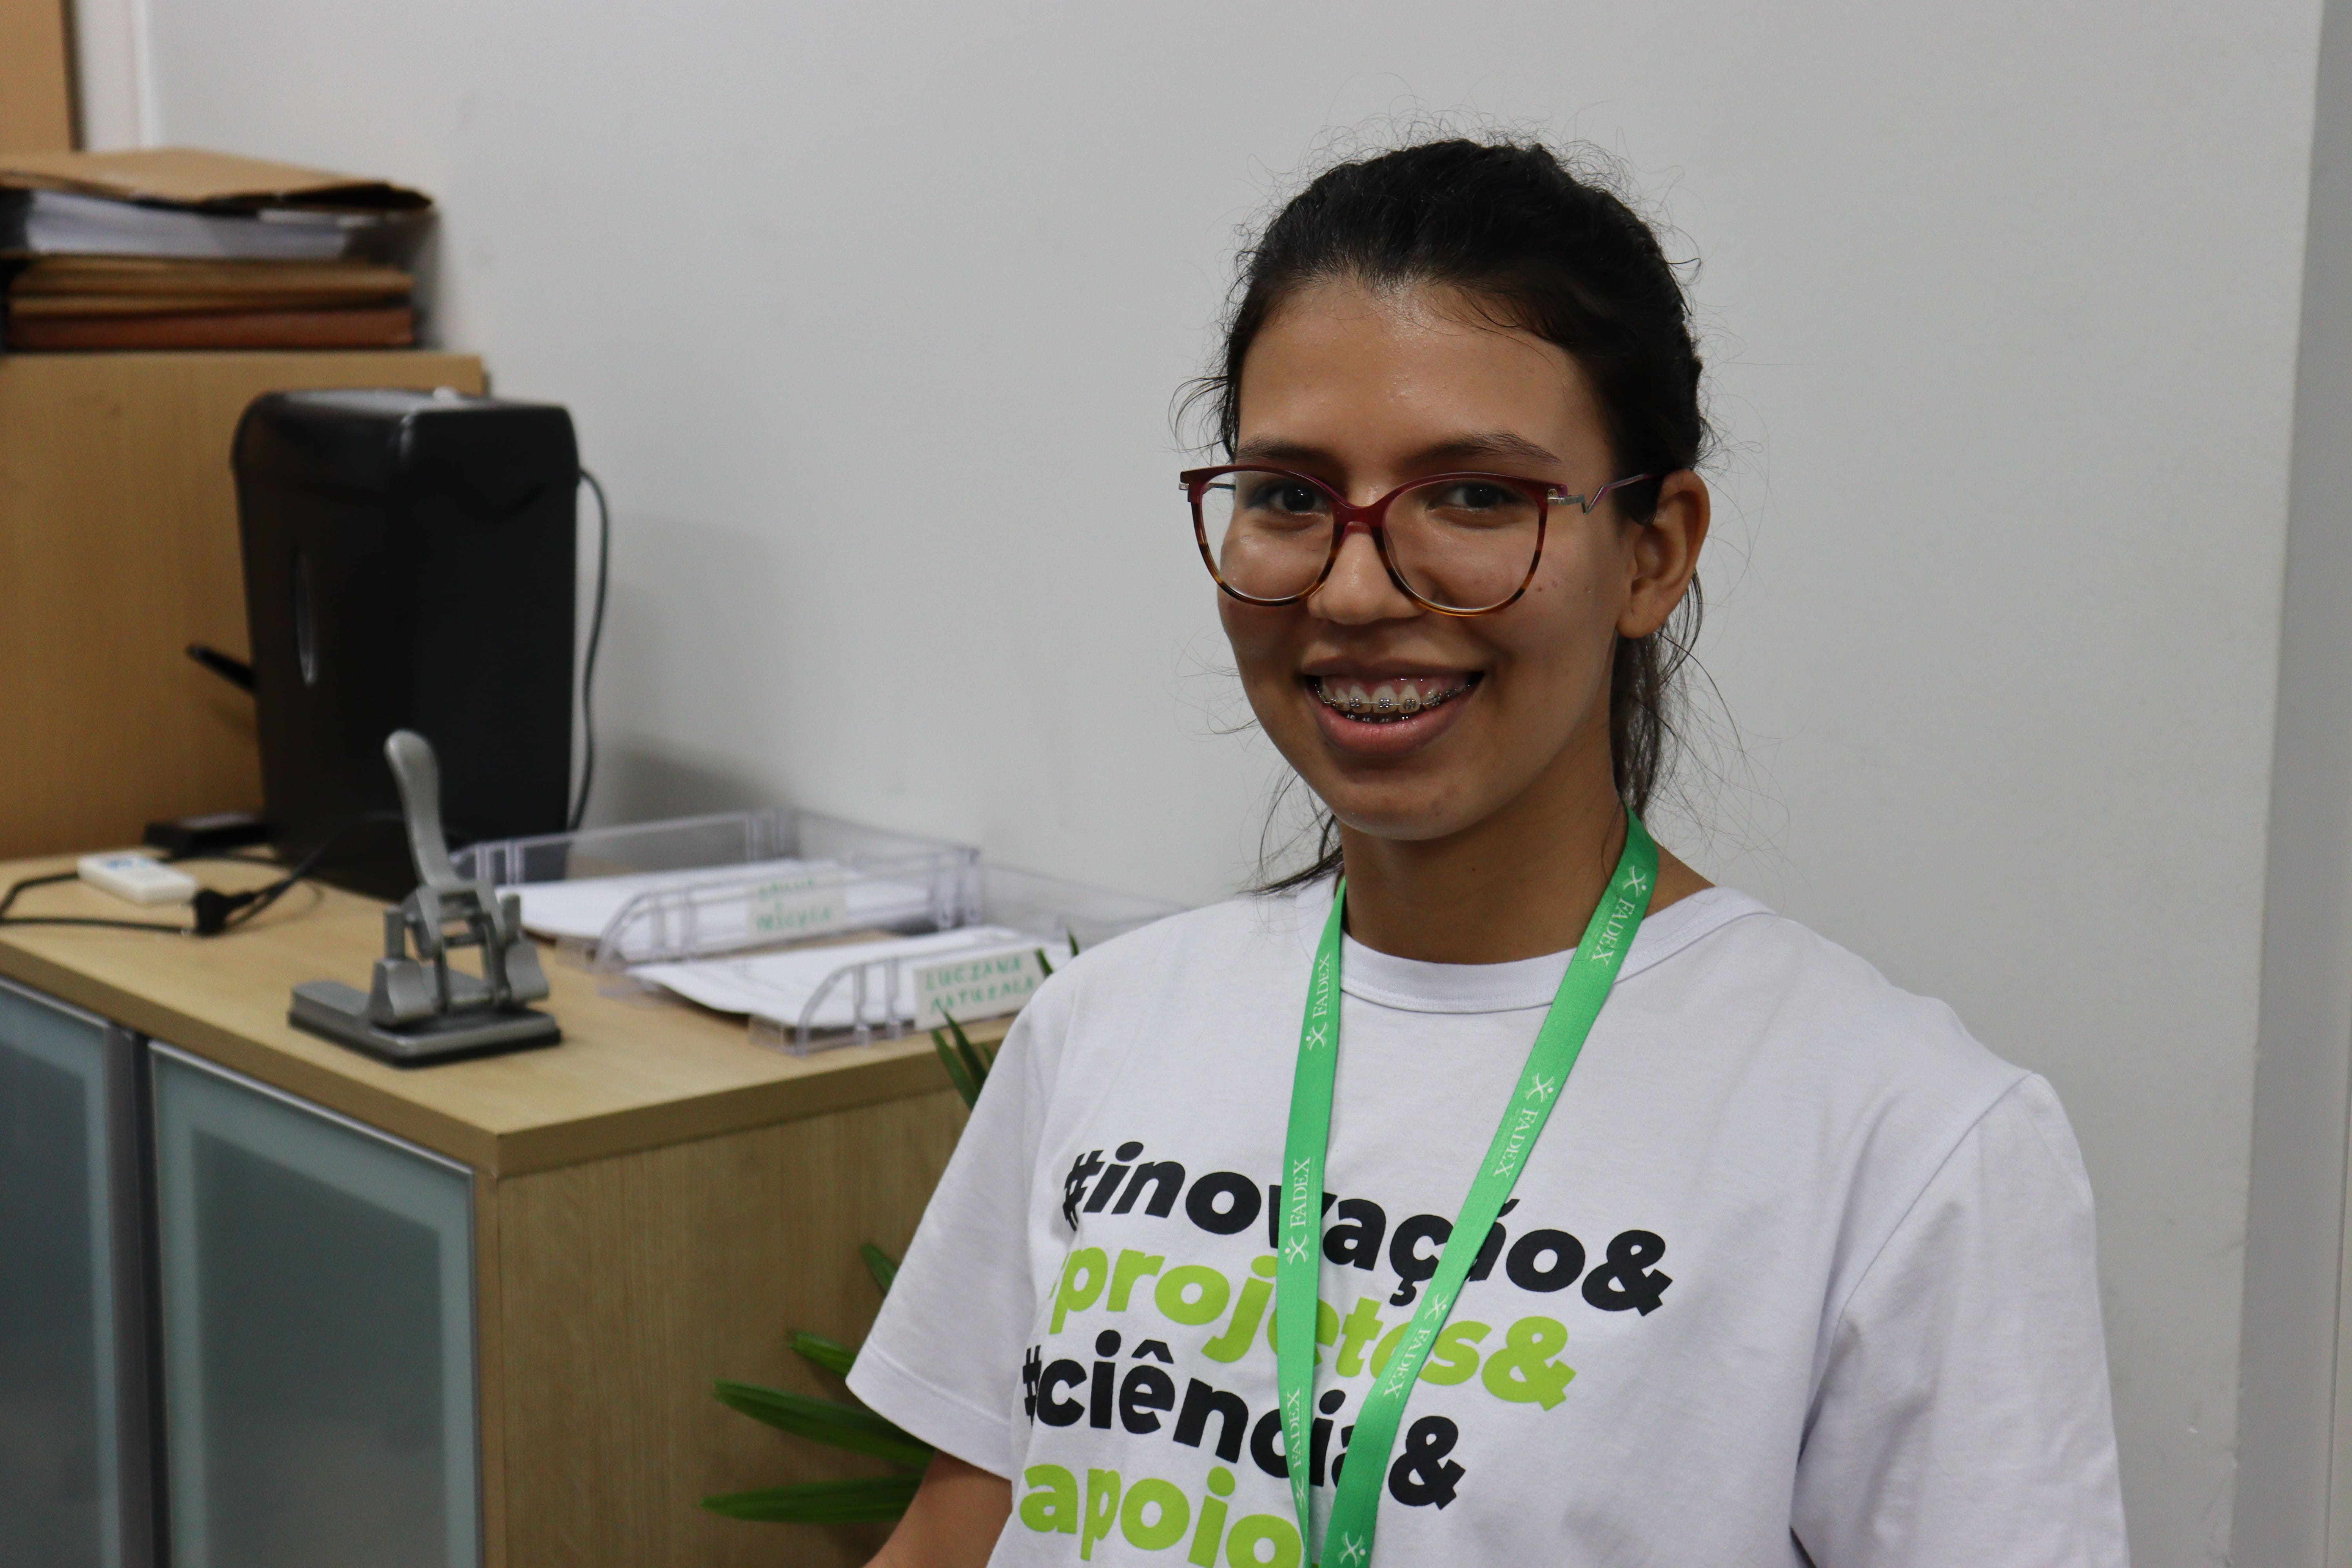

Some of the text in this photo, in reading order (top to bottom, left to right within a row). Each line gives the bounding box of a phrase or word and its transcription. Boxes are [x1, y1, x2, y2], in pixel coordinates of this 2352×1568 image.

[1590, 897, 1635, 967] FADEX
[1312, 952, 1330, 1020] FADEX
[1494, 1108, 1539, 1178] FADEX
[1290, 1156, 1310, 1229] FADEX
[1383, 1327, 1432, 1399] FADEX
[1287, 1387, 1301, 1471] FADEX
